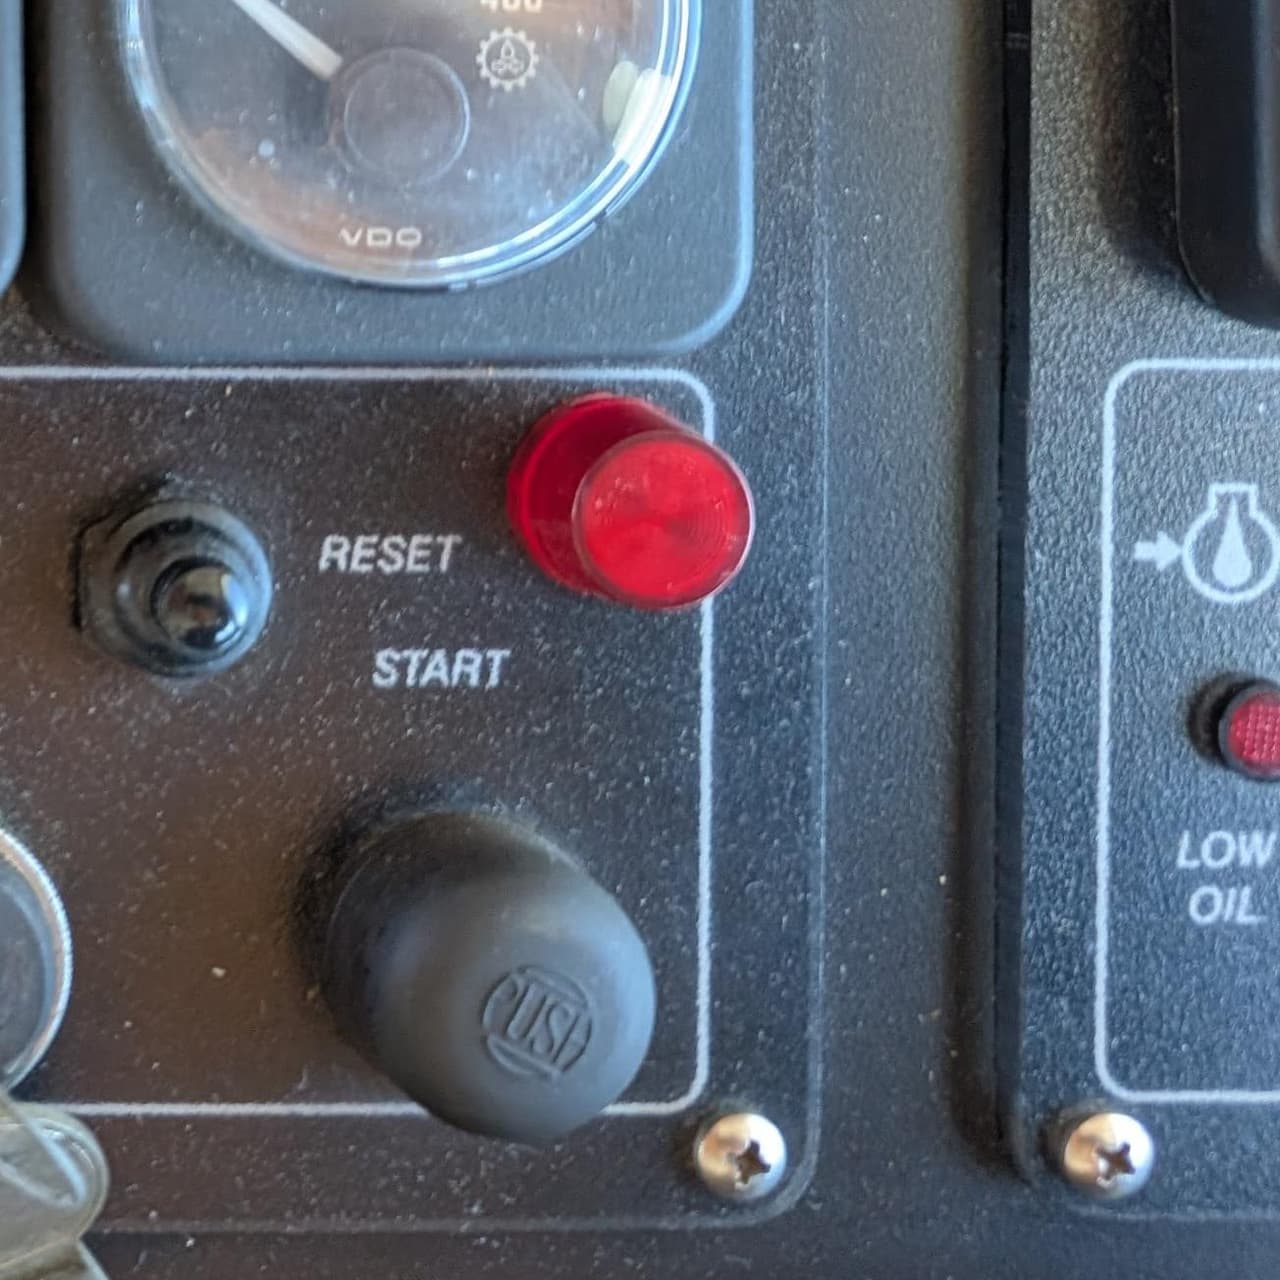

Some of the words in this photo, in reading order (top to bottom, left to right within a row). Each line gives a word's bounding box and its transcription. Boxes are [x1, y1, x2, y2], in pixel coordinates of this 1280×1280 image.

[339, 227, 423, 248] VDO
[318, 534, 462, 574] RESET
[371, 648, 511, 687] START
[1177, 829, 1278, 869] LOW
[1188, 884, 1269, 925] OIL
